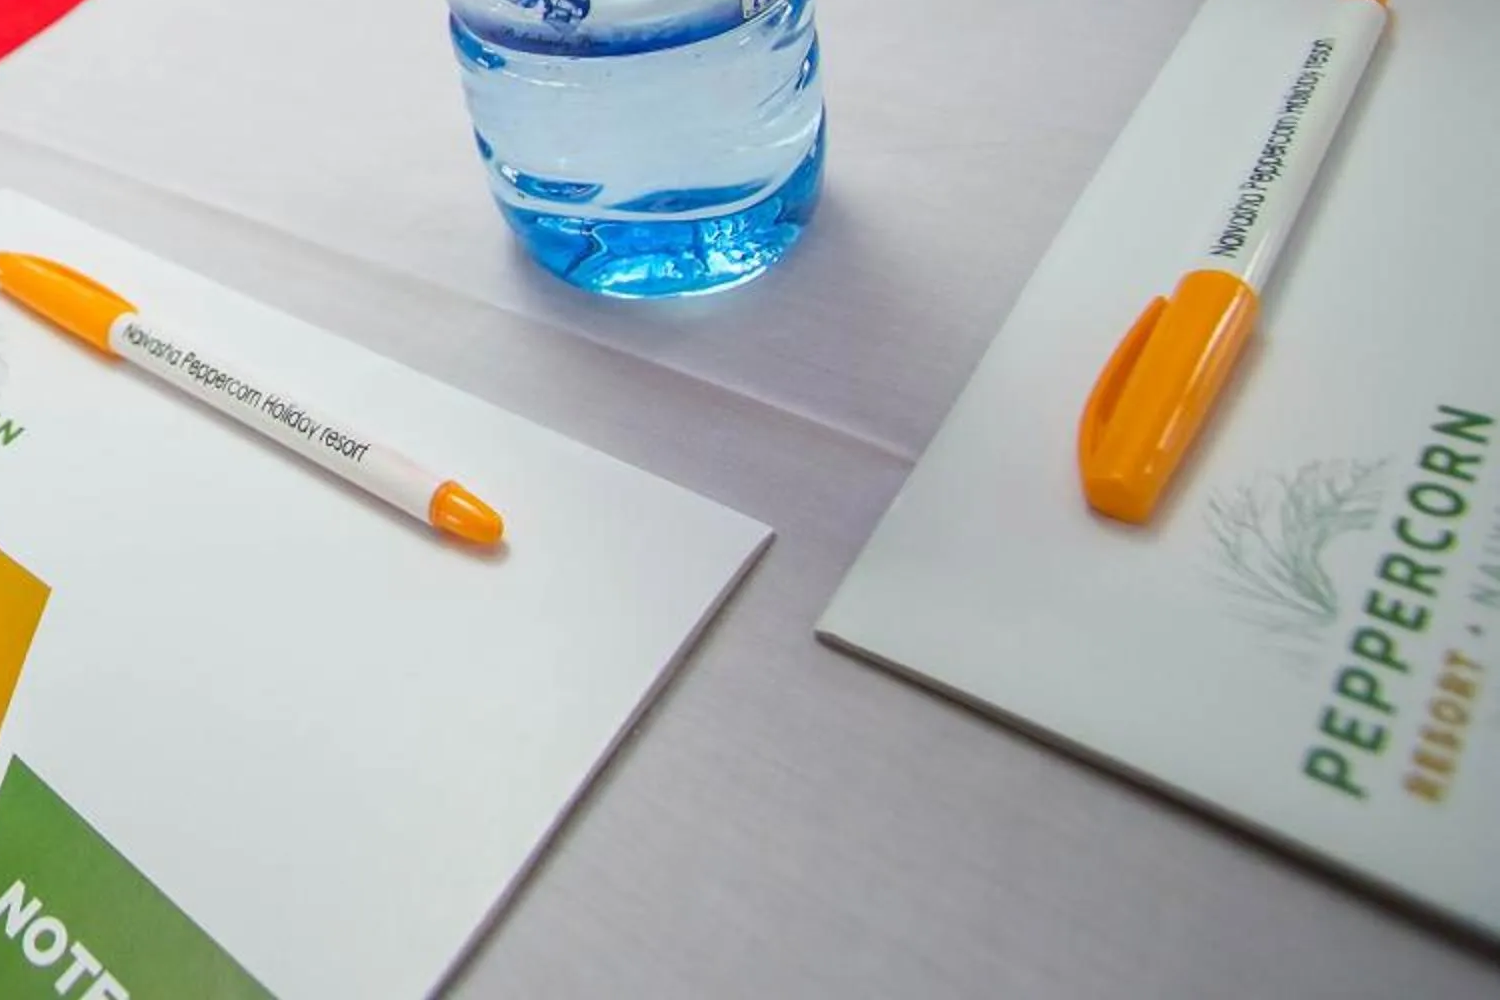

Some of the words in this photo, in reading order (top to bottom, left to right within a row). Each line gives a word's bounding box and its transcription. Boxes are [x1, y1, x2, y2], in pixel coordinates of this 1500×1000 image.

[122, 323, 183, 366] Naivasha
[182, 351, 263, 408] Peppercorn
[262, 393, 321, 440] Holiday
[319, 426, 372, 463] resort
[1302, 403, 1497, 801] PEPPERCORN
